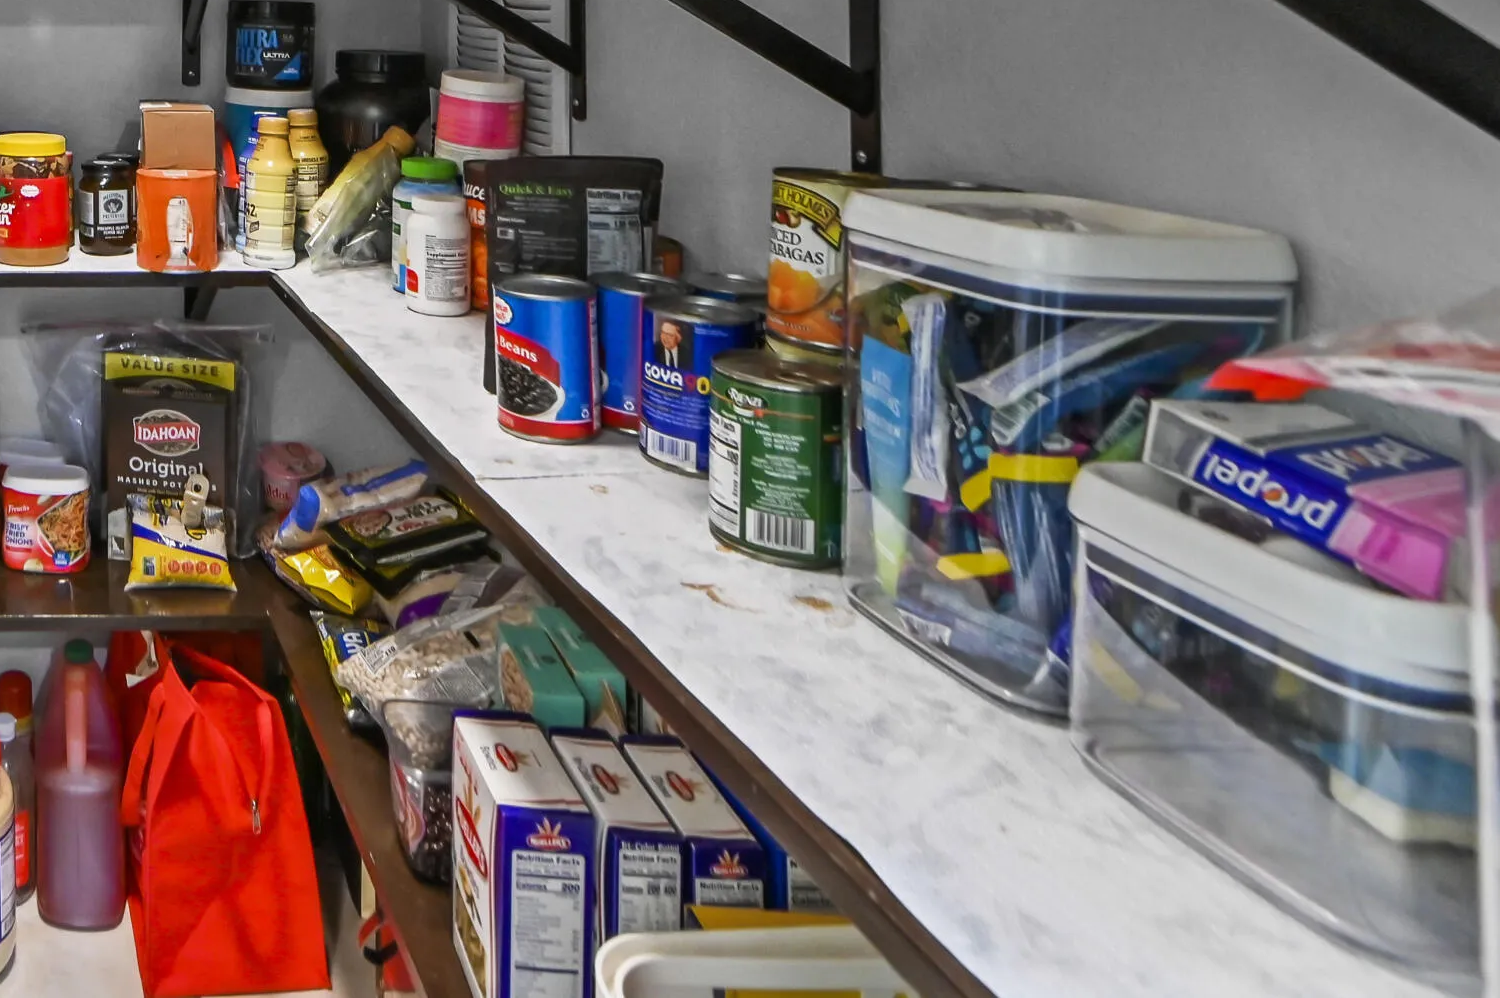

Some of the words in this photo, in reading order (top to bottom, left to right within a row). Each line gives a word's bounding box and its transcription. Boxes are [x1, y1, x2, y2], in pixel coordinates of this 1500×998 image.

[499, 184, 533, 197] Quick
[535, 185, 544, 195] &
[547, 185, 573, 198] Easy
[499, 335, 538, 363] Beans
[121, 358, 174, 373] VALUE
[182, 364, 219, 377] SIZE
[644, 362, 683, 387] GOYA
[138, 426, 196, 440] IDAHOAN
[129, 456, 203, 477] Original
[117, 476, 158, 486] MASHED
[1203, 455, 1338, 530] propel
[516, 854, 552, 864] Nutrition
[555, 856, 581, 866] Facts
[622, 853, 654, 864] Nutrition
[657, 854, 678, 865] Facts
[561, 883, 581, 894] 200
[699, 881, 734, 891] Nutrition
